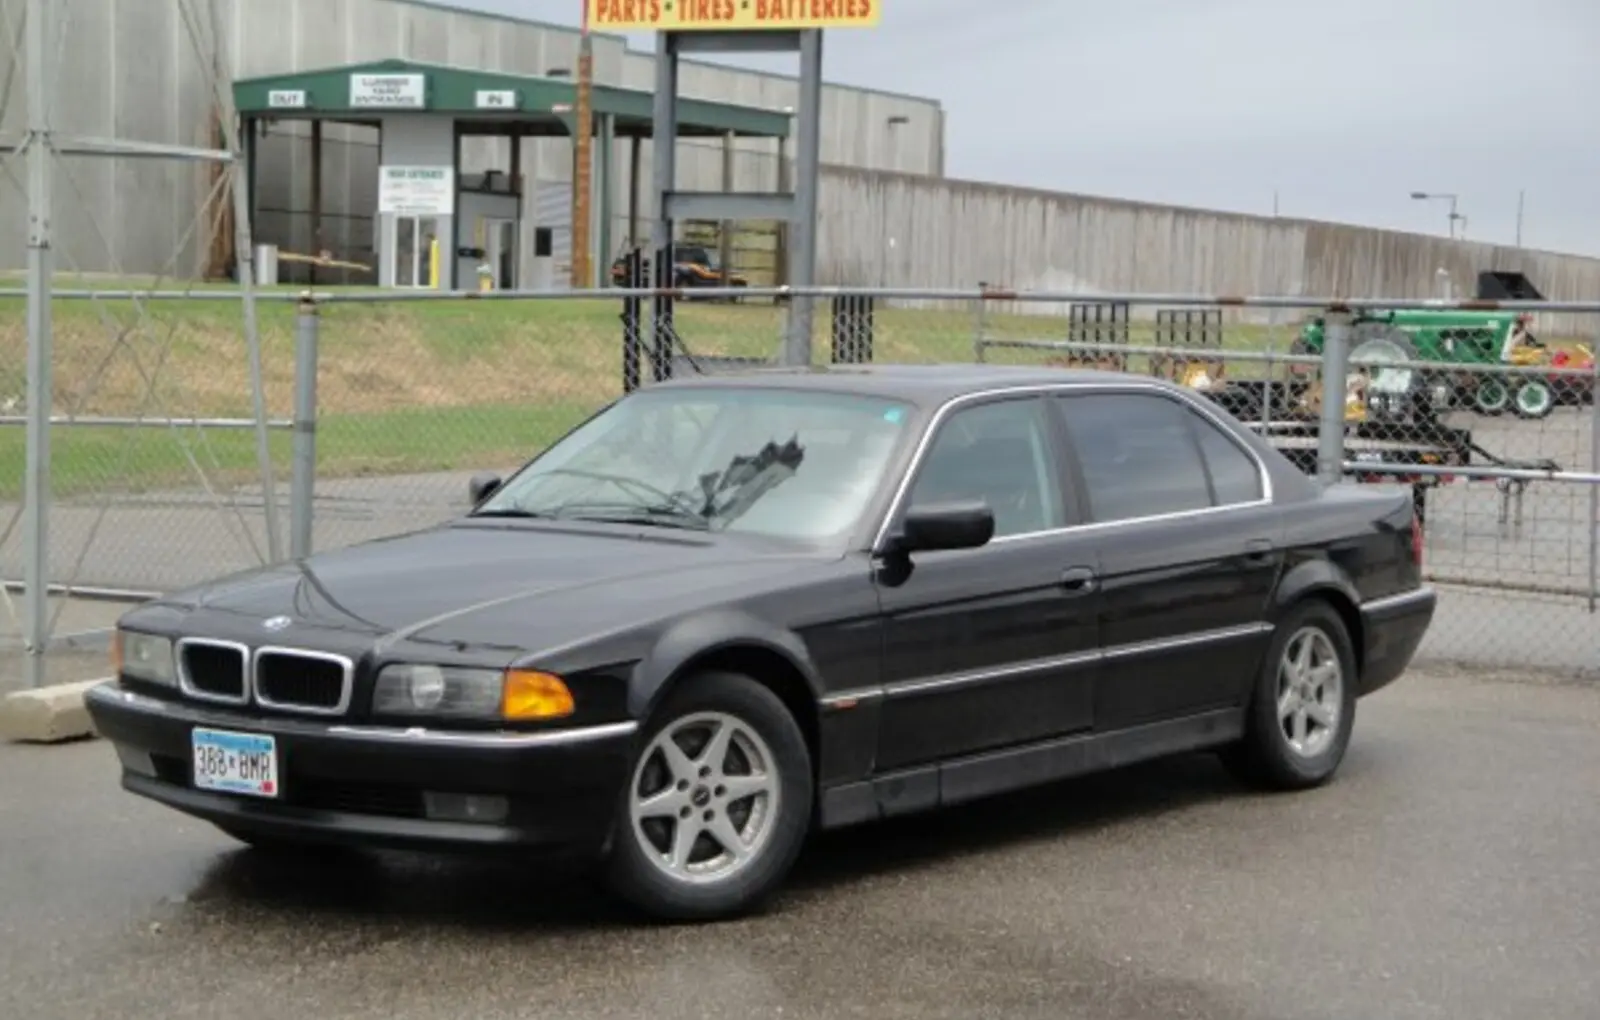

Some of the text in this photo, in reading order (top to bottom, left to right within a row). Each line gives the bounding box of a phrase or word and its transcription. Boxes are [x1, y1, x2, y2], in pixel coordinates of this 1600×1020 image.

[596, 0, 870, 22] PARTS TIRES BATTERIES
[488, 94, 502, 105] IN
